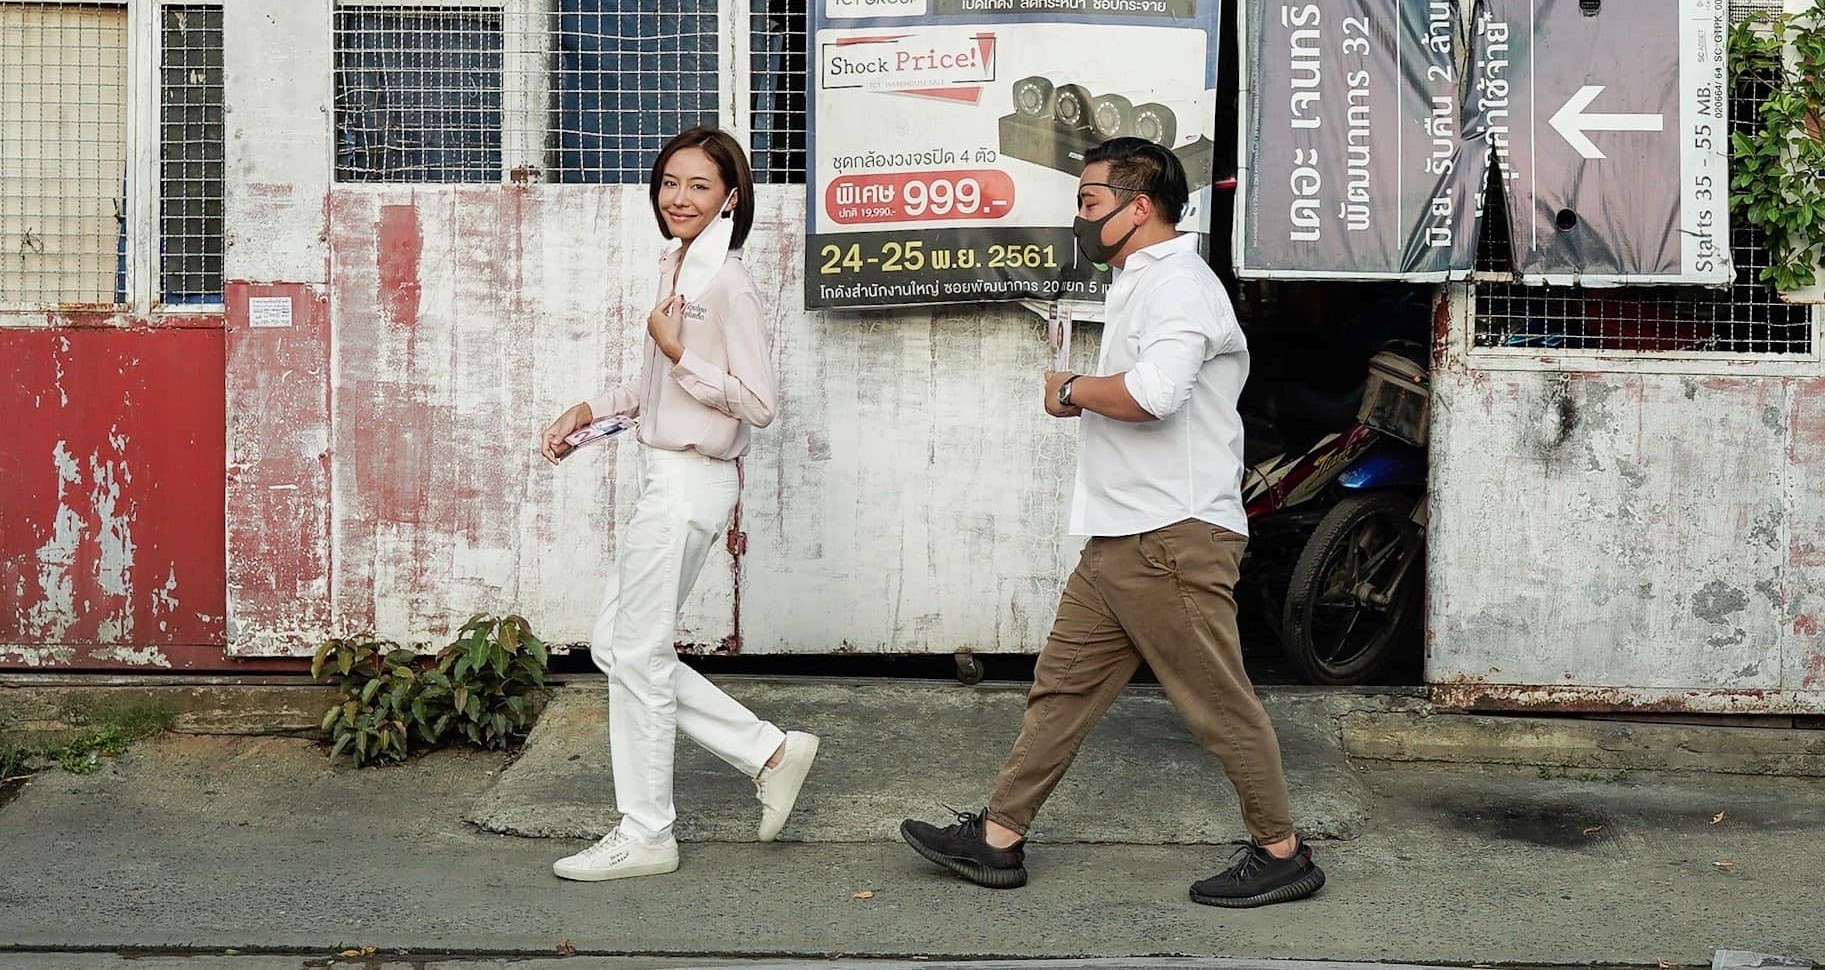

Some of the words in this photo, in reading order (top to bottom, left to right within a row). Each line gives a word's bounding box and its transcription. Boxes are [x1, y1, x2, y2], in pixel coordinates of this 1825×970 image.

[1342, 16, 1370, 56] 32
[1421, 1, 1451, 54] ล้าน
[830, 56, 889, 76] Shock
[895, 47, 977, 72] Price!
[1427, 65, 1452, 82] 2
[1696, 82, 1711, 117] MB.
[1337, 69, 1370, 231] พัฒนาการ
[1424, 96, 1454, 176] รับคืน
[1695, 124, 1712, 150] 55
[833, 147, 955, 174] ชุดกล้องวงจรปิด
[960, 149, 970, 163] 4
[975, 147, 997, 163] ตัว
[836, 182, 896, 205] พิเศษ
[903, 177, 1008, 216] 999.-
[1289, 148, 1322, 242] เดอะ
[1695, 175, 1712, 201] 35
[838, 207, 858, 218] ปกติ
[1425, 187, 1453, 248] มิ.ย.
[820, 240, 926, 274] 24-25
[931, 248, 982, 270] พ.ย.
[987, 244, 1058, 268] 2561
[1695, 209, 1713, 273] Starts
[819, 279, 940, 300] โกดังสำนักงานใหญ่
[943, 278, 1039, 295] ซอยพัฒนาการ
[1042, 280, 1060, 293] 20
[1088, 282, 1098, 294] 5
